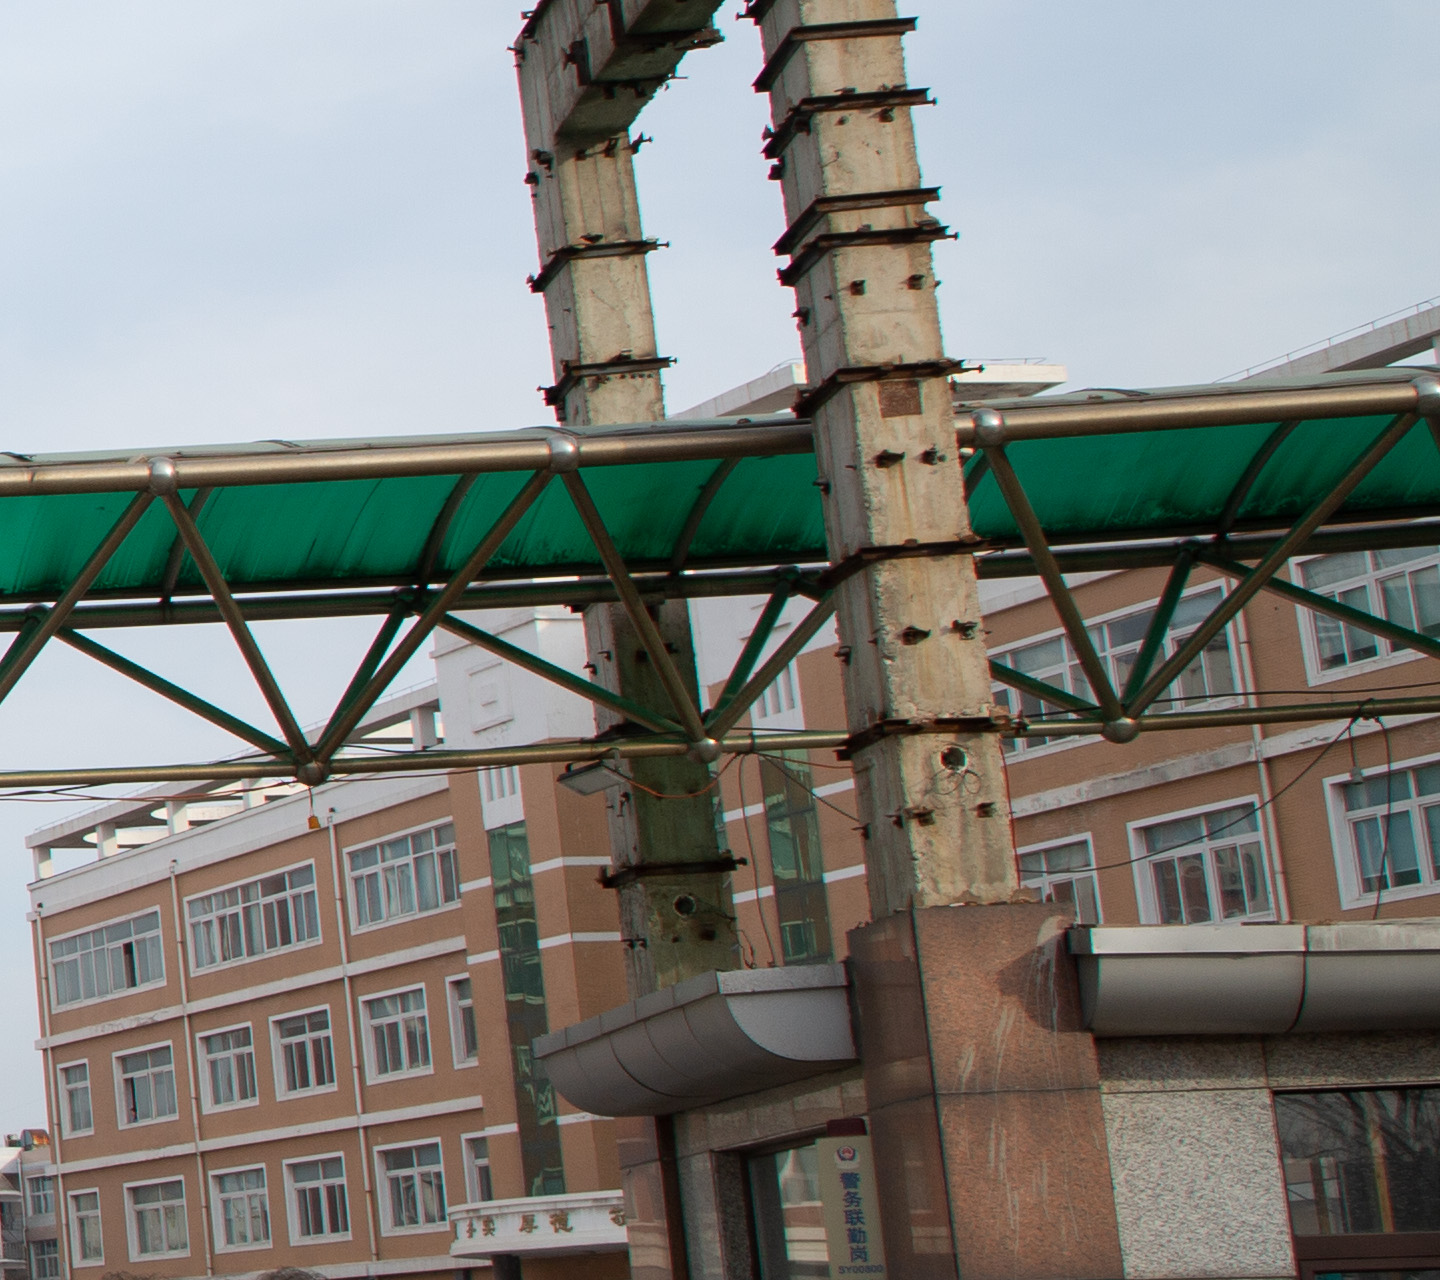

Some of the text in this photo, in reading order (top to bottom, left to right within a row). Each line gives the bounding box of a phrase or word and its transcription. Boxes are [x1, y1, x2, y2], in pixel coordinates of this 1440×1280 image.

[840, 1172, 868, 1262] 警务联勤岗
